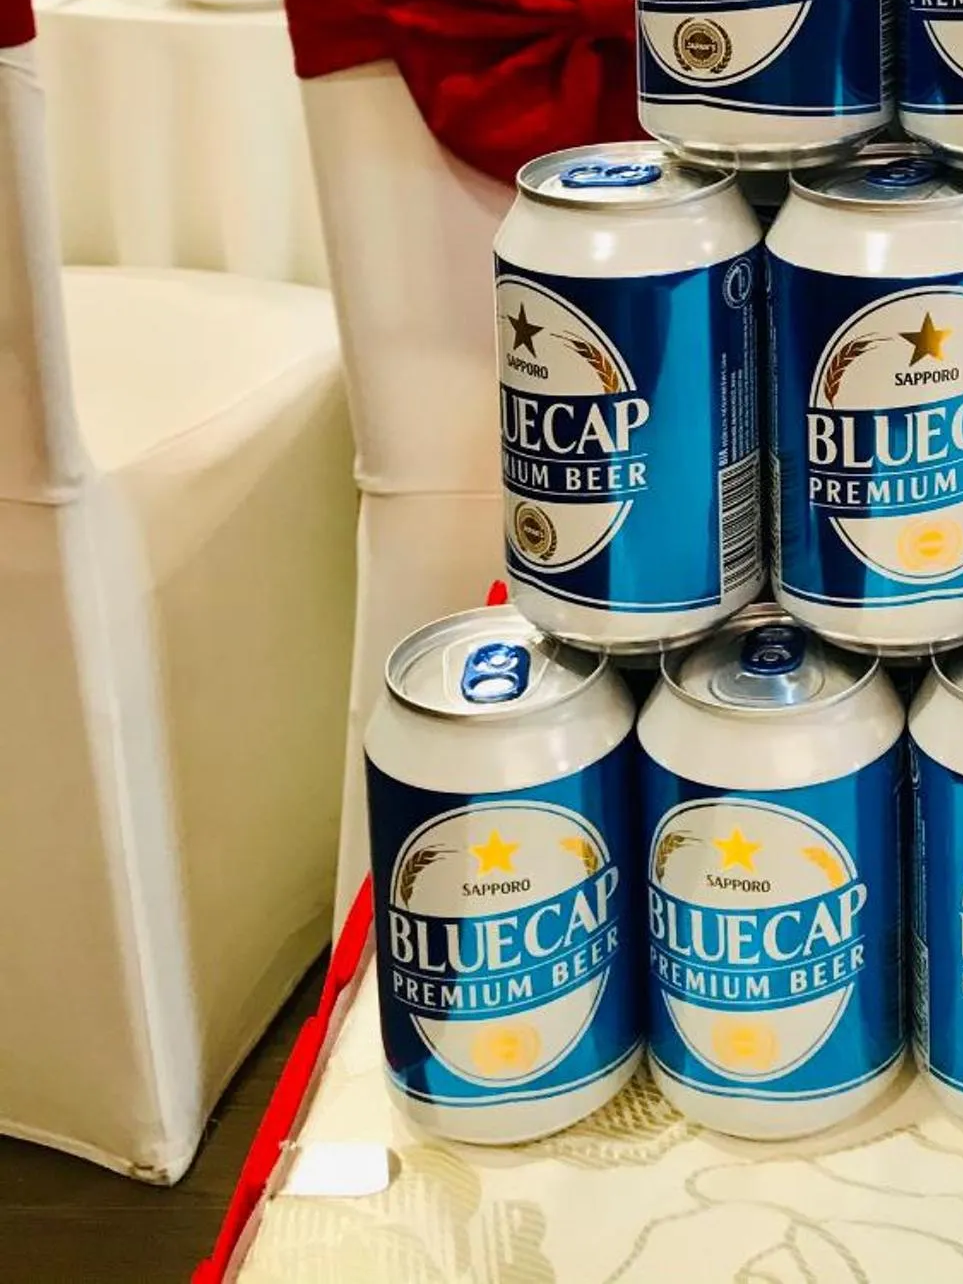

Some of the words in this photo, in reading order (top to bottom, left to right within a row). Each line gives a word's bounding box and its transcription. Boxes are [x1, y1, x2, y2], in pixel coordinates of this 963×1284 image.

[506, 353, 549, 380] SAPPORO
[895, 368, 959, 387] SAPPORO
[501, 387, 650, 454] UECAP
[566, 462, 647, 491] BEER
[810, 469, 956, 505] PREMIUM
[462, 879, 530, 897] SAPPORO
[707, 875, 771, 893] SAPPORO
[388, 865, 619, 973] BLUECAP
[648, 883, 867, 965] BLUECAP
[393, 970, 532, 1008] PREMIUM
[553, 928, 618, 985] BEER
[650, 946, 769, 999] PREMIUM
[790, 944, 866, 994] BEER
